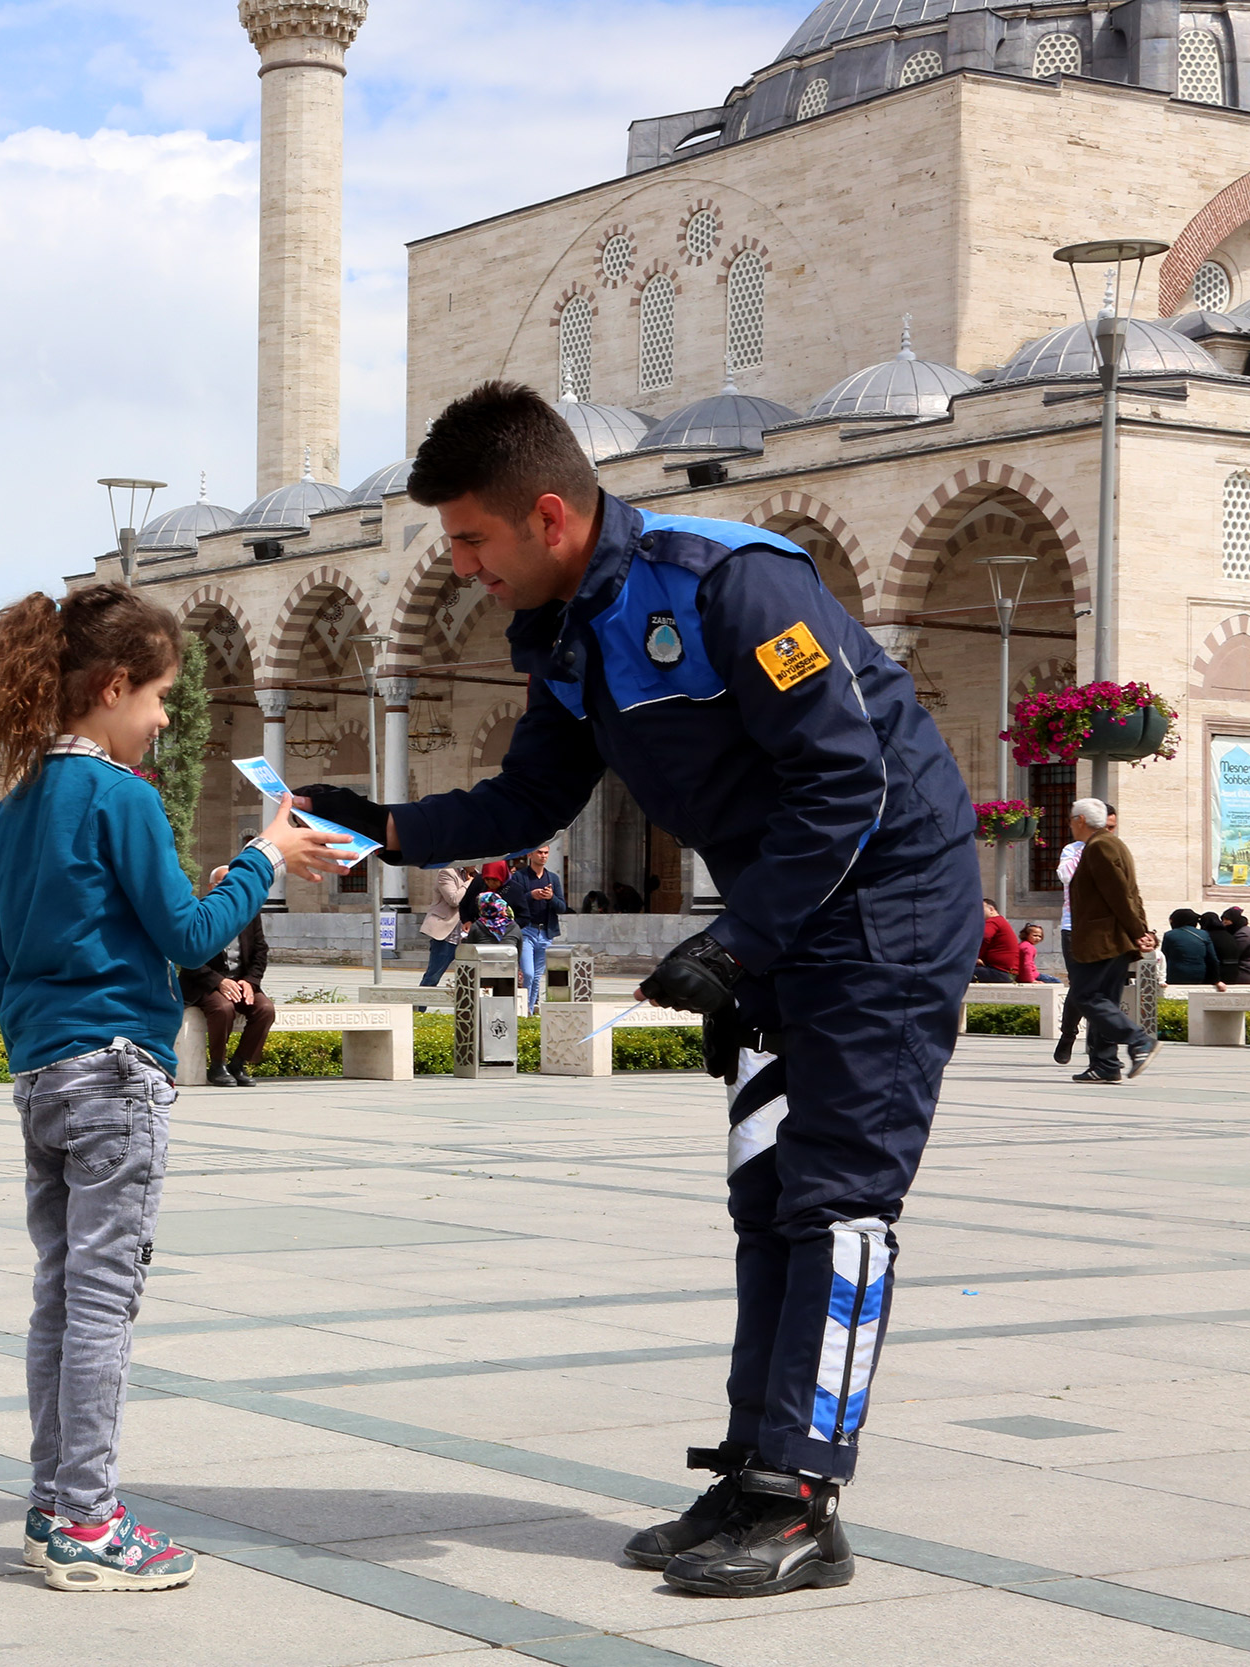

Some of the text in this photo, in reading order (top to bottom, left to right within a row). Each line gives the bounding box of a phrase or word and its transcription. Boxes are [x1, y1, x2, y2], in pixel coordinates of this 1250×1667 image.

[776, 651, 822, 681] BÜYÜKŞEHİR
[783, 651, 806, 667] KONYA
[325, 1009, 389, 1025] BELEDİYESİ
